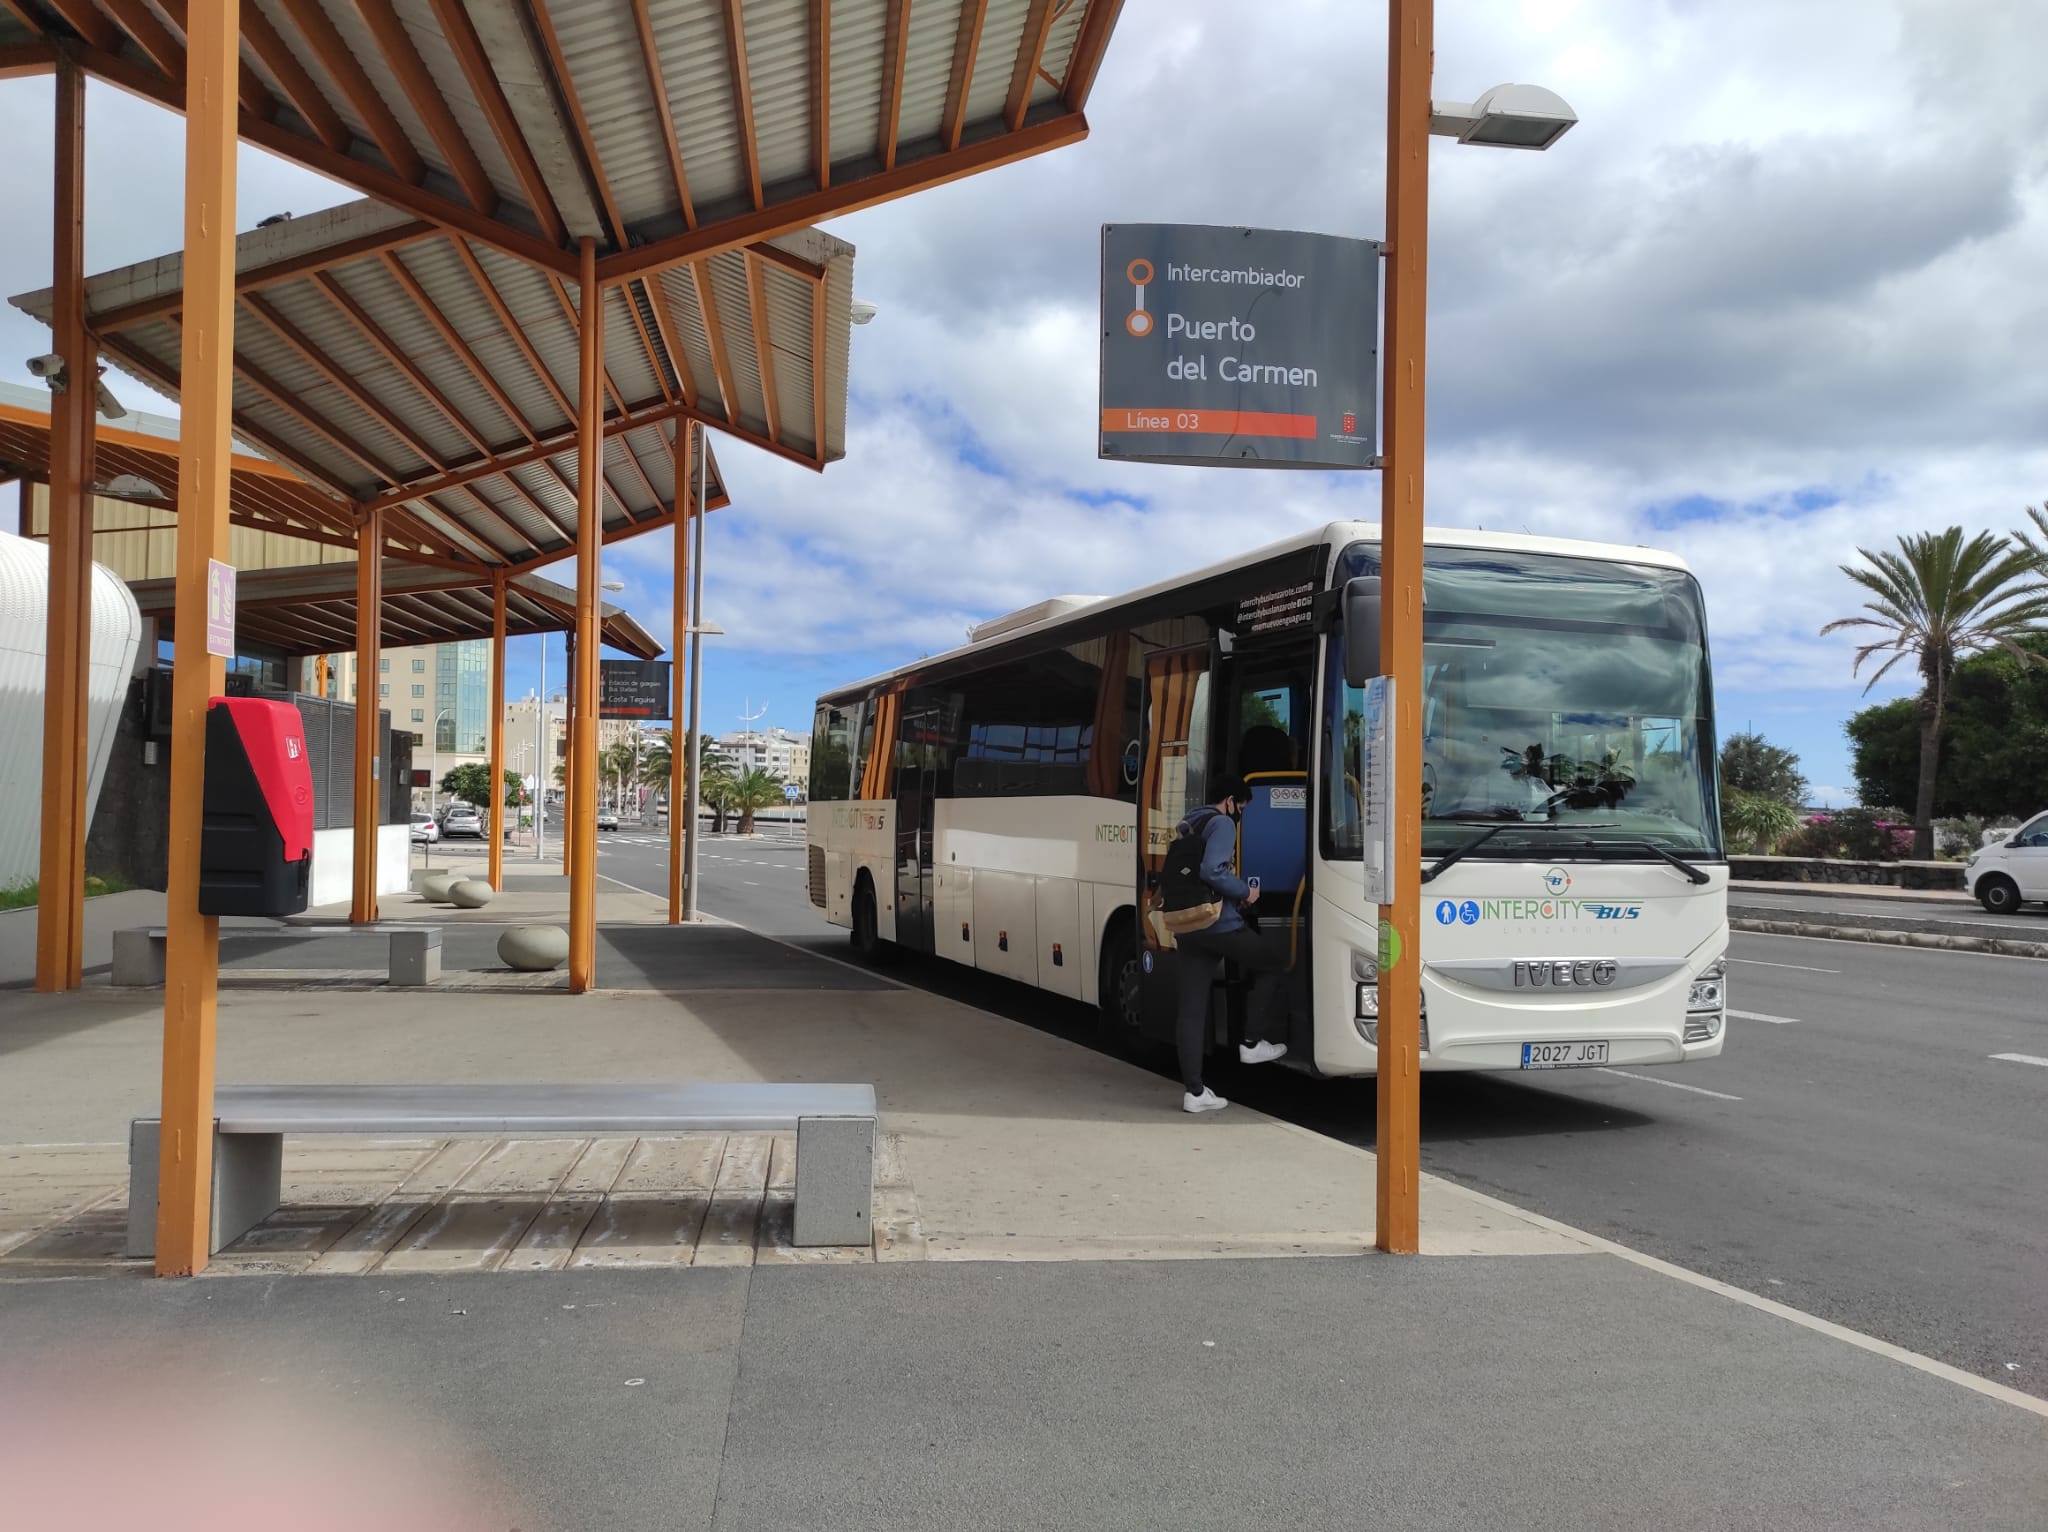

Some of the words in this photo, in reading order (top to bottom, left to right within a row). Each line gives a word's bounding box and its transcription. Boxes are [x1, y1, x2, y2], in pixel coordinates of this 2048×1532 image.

[1167, 262, 1305, 288] Intercambiador
[1167, 313, 1256, 342] Puerto
[1166, 355, 1207, 380] del
[1218, 357, 1317, 387] Carmen
[1127, 412, 1170, 429] Línea
[1177, 413, 1199, 429] 03
[1482, 900, 1583, 920] INTERCITY
[1594, 906, 1641, 920] BUS
[1513, 960, 1617, 987] IVECO
[1532, 1045, 1572, 1062] 2027
[1577, 1044, 1606, 1060] JGT
